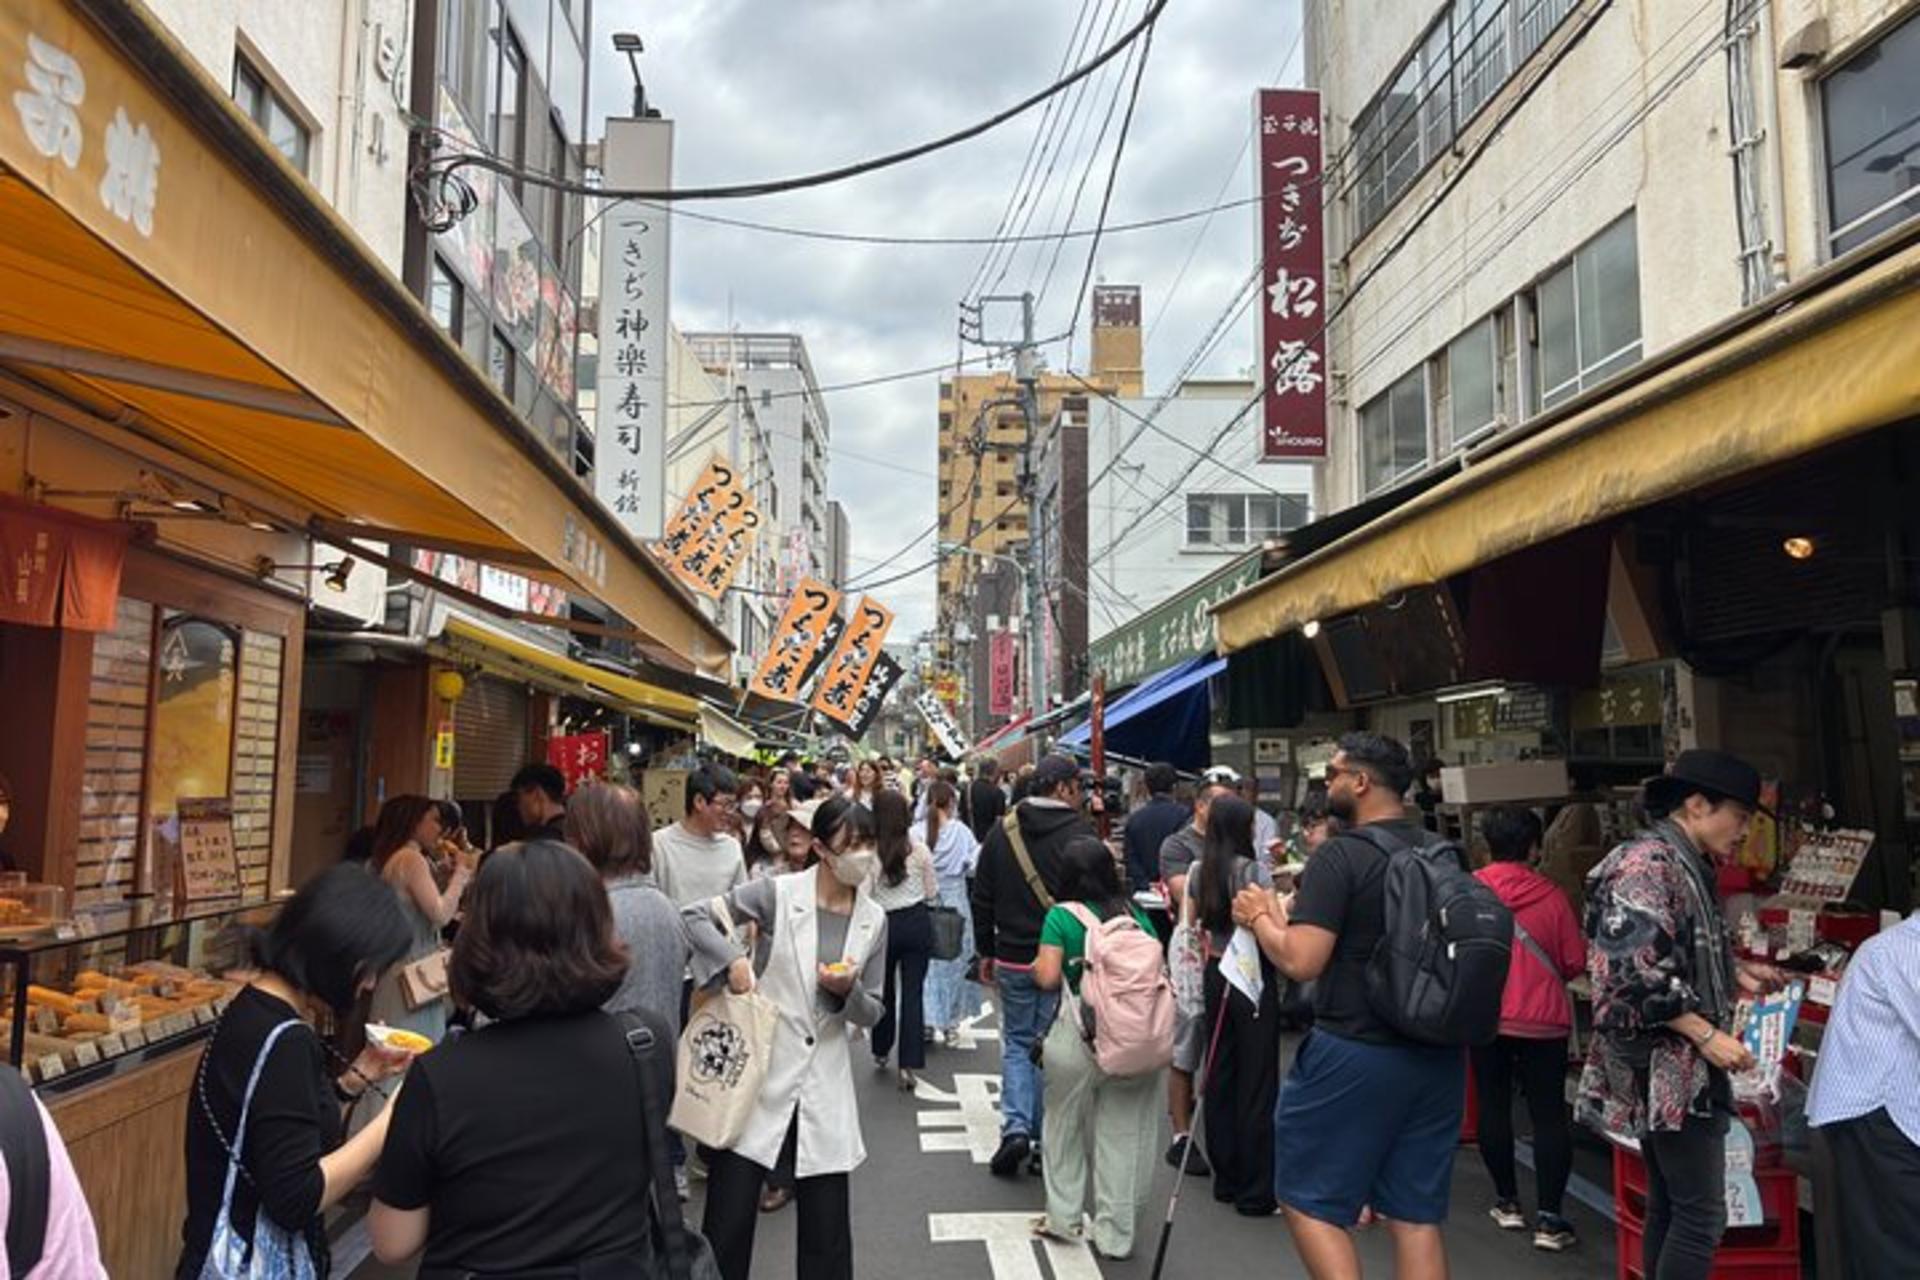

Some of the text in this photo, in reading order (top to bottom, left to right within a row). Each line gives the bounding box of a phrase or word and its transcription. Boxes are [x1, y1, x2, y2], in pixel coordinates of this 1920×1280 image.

[762, 588, 831, 694] つくだ煮
[823, 605, 885, 711] つくだ煮
